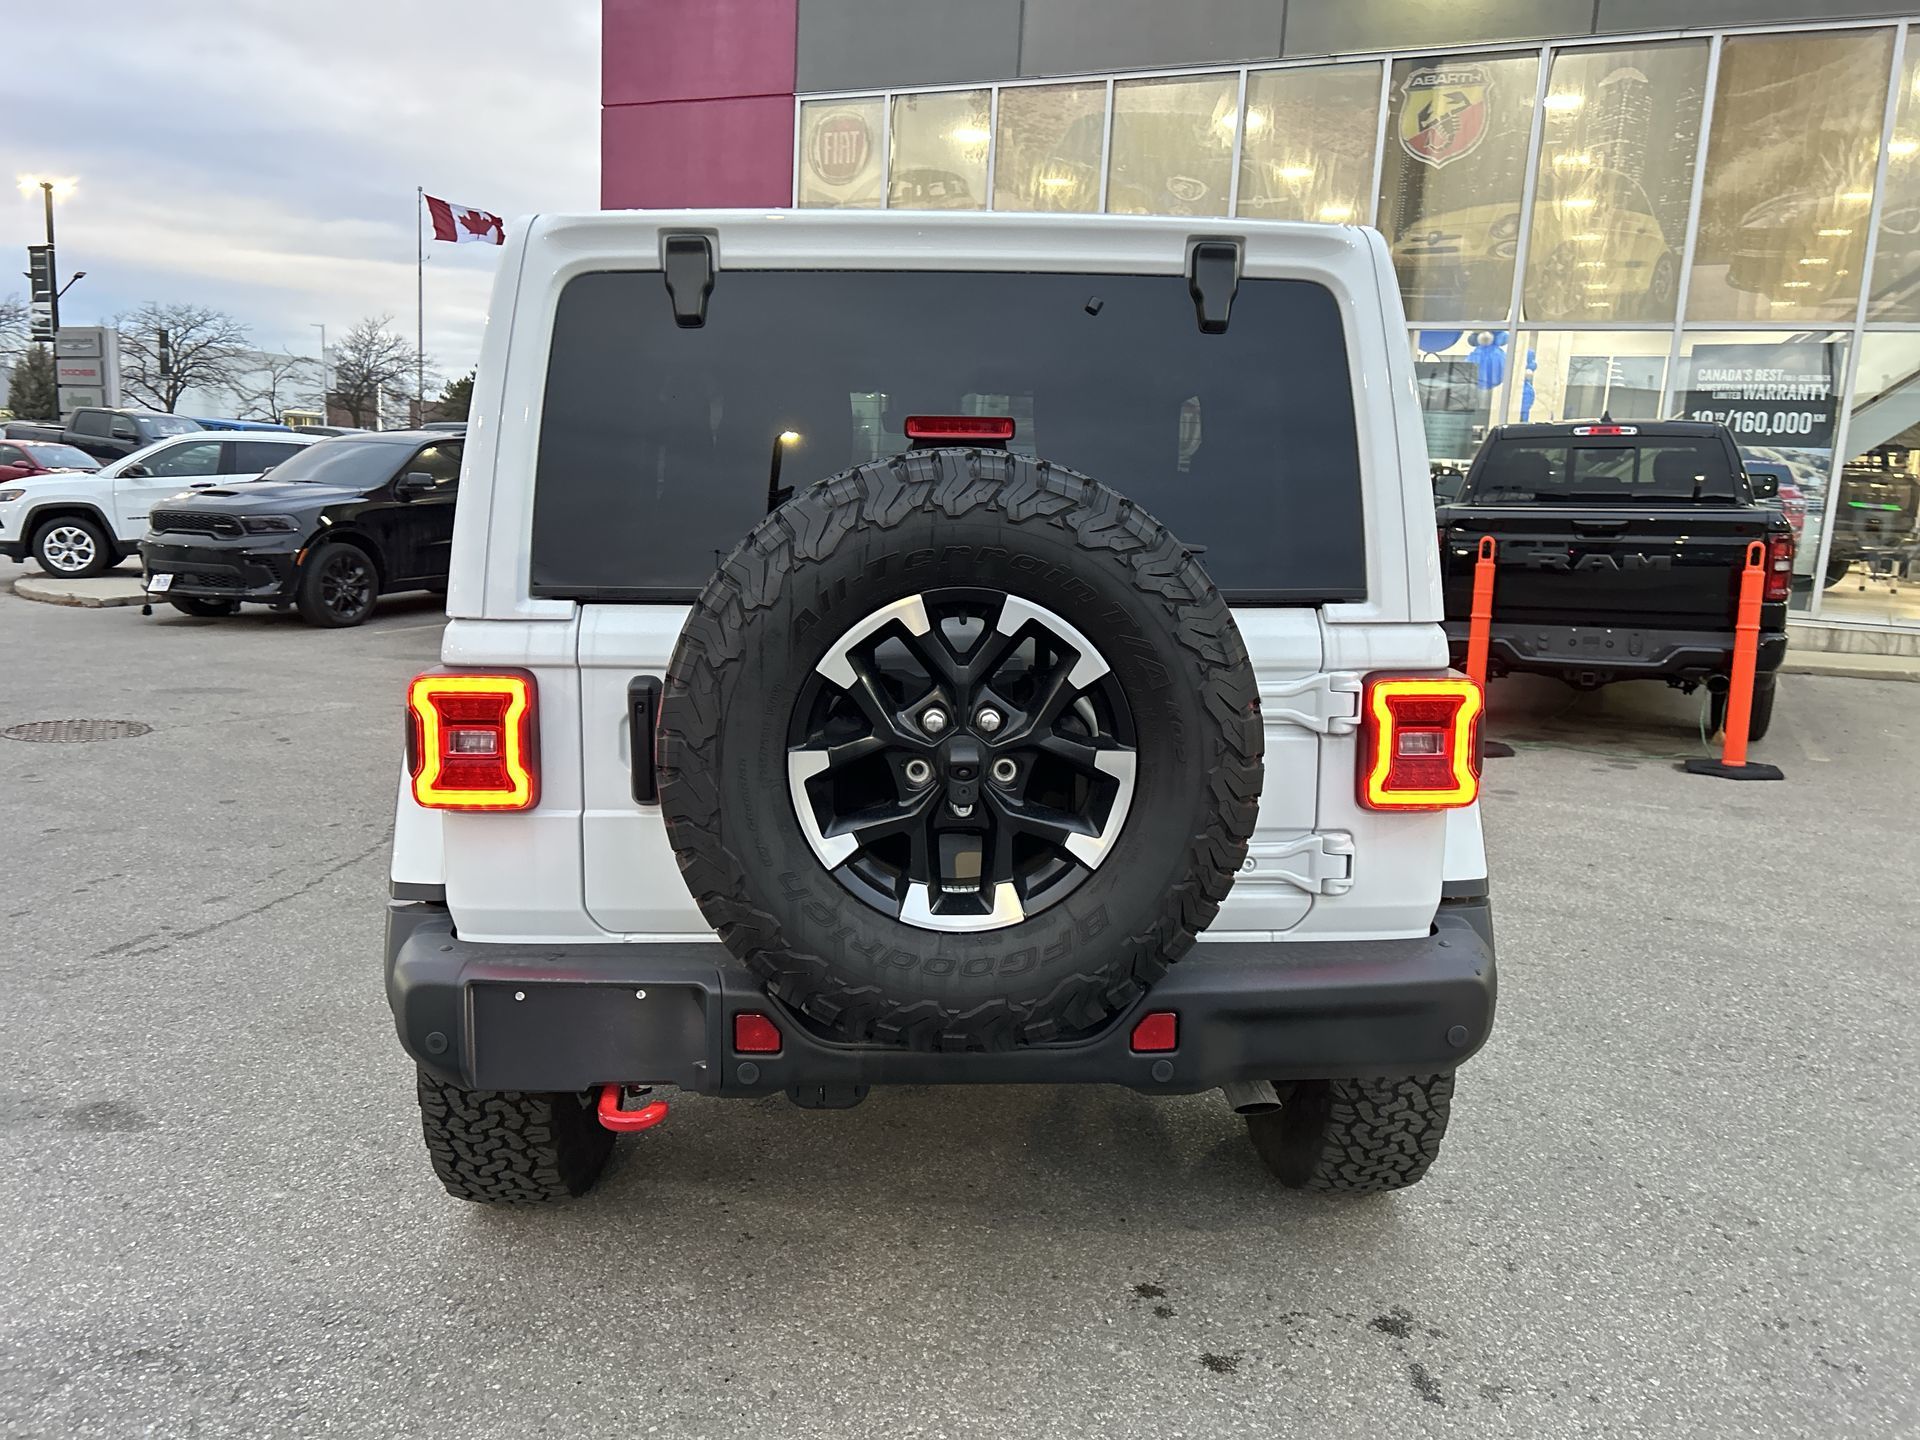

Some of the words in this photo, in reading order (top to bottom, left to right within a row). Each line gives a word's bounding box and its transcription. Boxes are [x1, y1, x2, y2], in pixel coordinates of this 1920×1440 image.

[1411, 72, 1481, 86] ABARTH
[824, 130, 860, 165] FIAT
[1697, 369, 1753, 382] CANADA'S
[1754, 369, 1784, 382] BEST
[1742, 384, 1831, 401] WARRANTY
[1528, 552, 1672, 571] RAM
